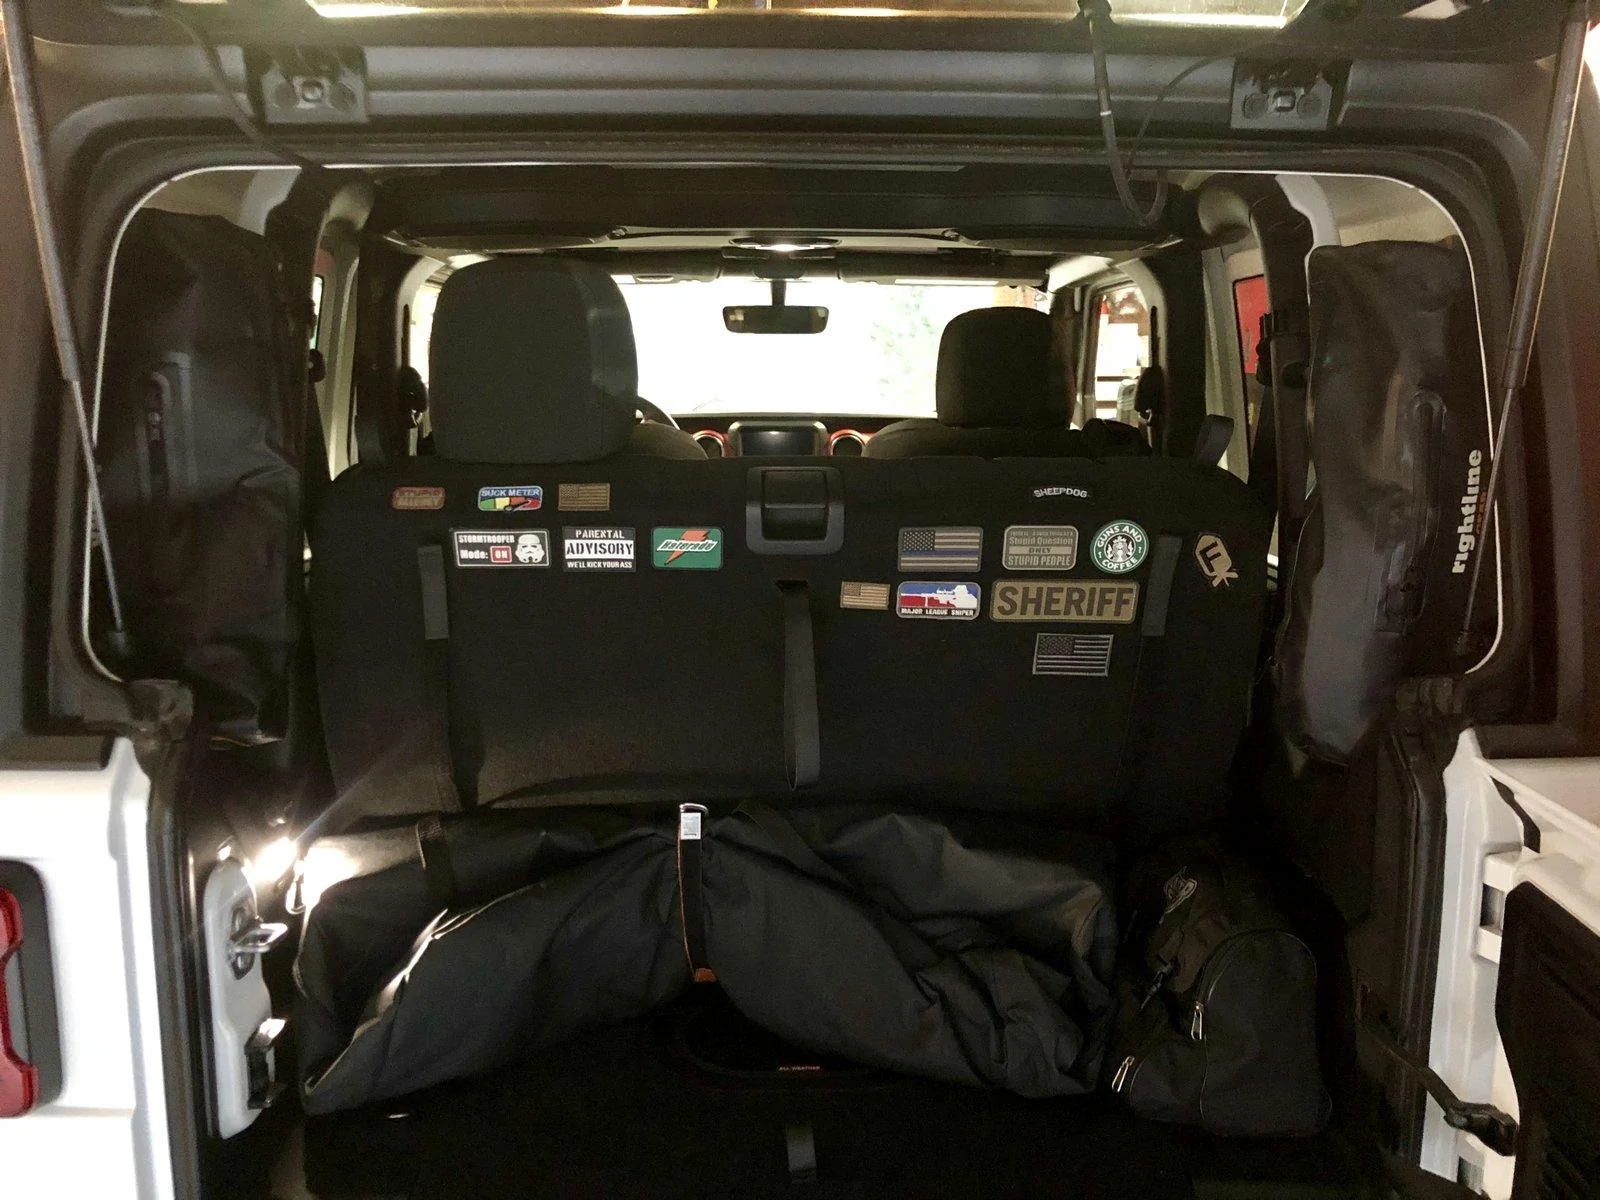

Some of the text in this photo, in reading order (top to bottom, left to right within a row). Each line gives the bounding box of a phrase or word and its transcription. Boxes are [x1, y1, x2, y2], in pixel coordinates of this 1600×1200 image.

[481, 488, 540, 497] SUCK METER
[1033, 487, 1088, 498] SHEEPDOG
[1452, 449, 1482, 573] rightline
[458, 535, 515, 544] STORMTROOPER
[575, 530, 625, 539] PARENTAL
[1097, 525, 1143, 548] GUNS AND
[566, 542, 633, 555] ADVISORY
[460, 549, 508, 560] Mode: ON
[1008, 555, 1071, 566] STUPID PEOPLE
[1102, 558, 1138, 571] COFFEE
[997, 586, 1134, 616] SHERIFF
